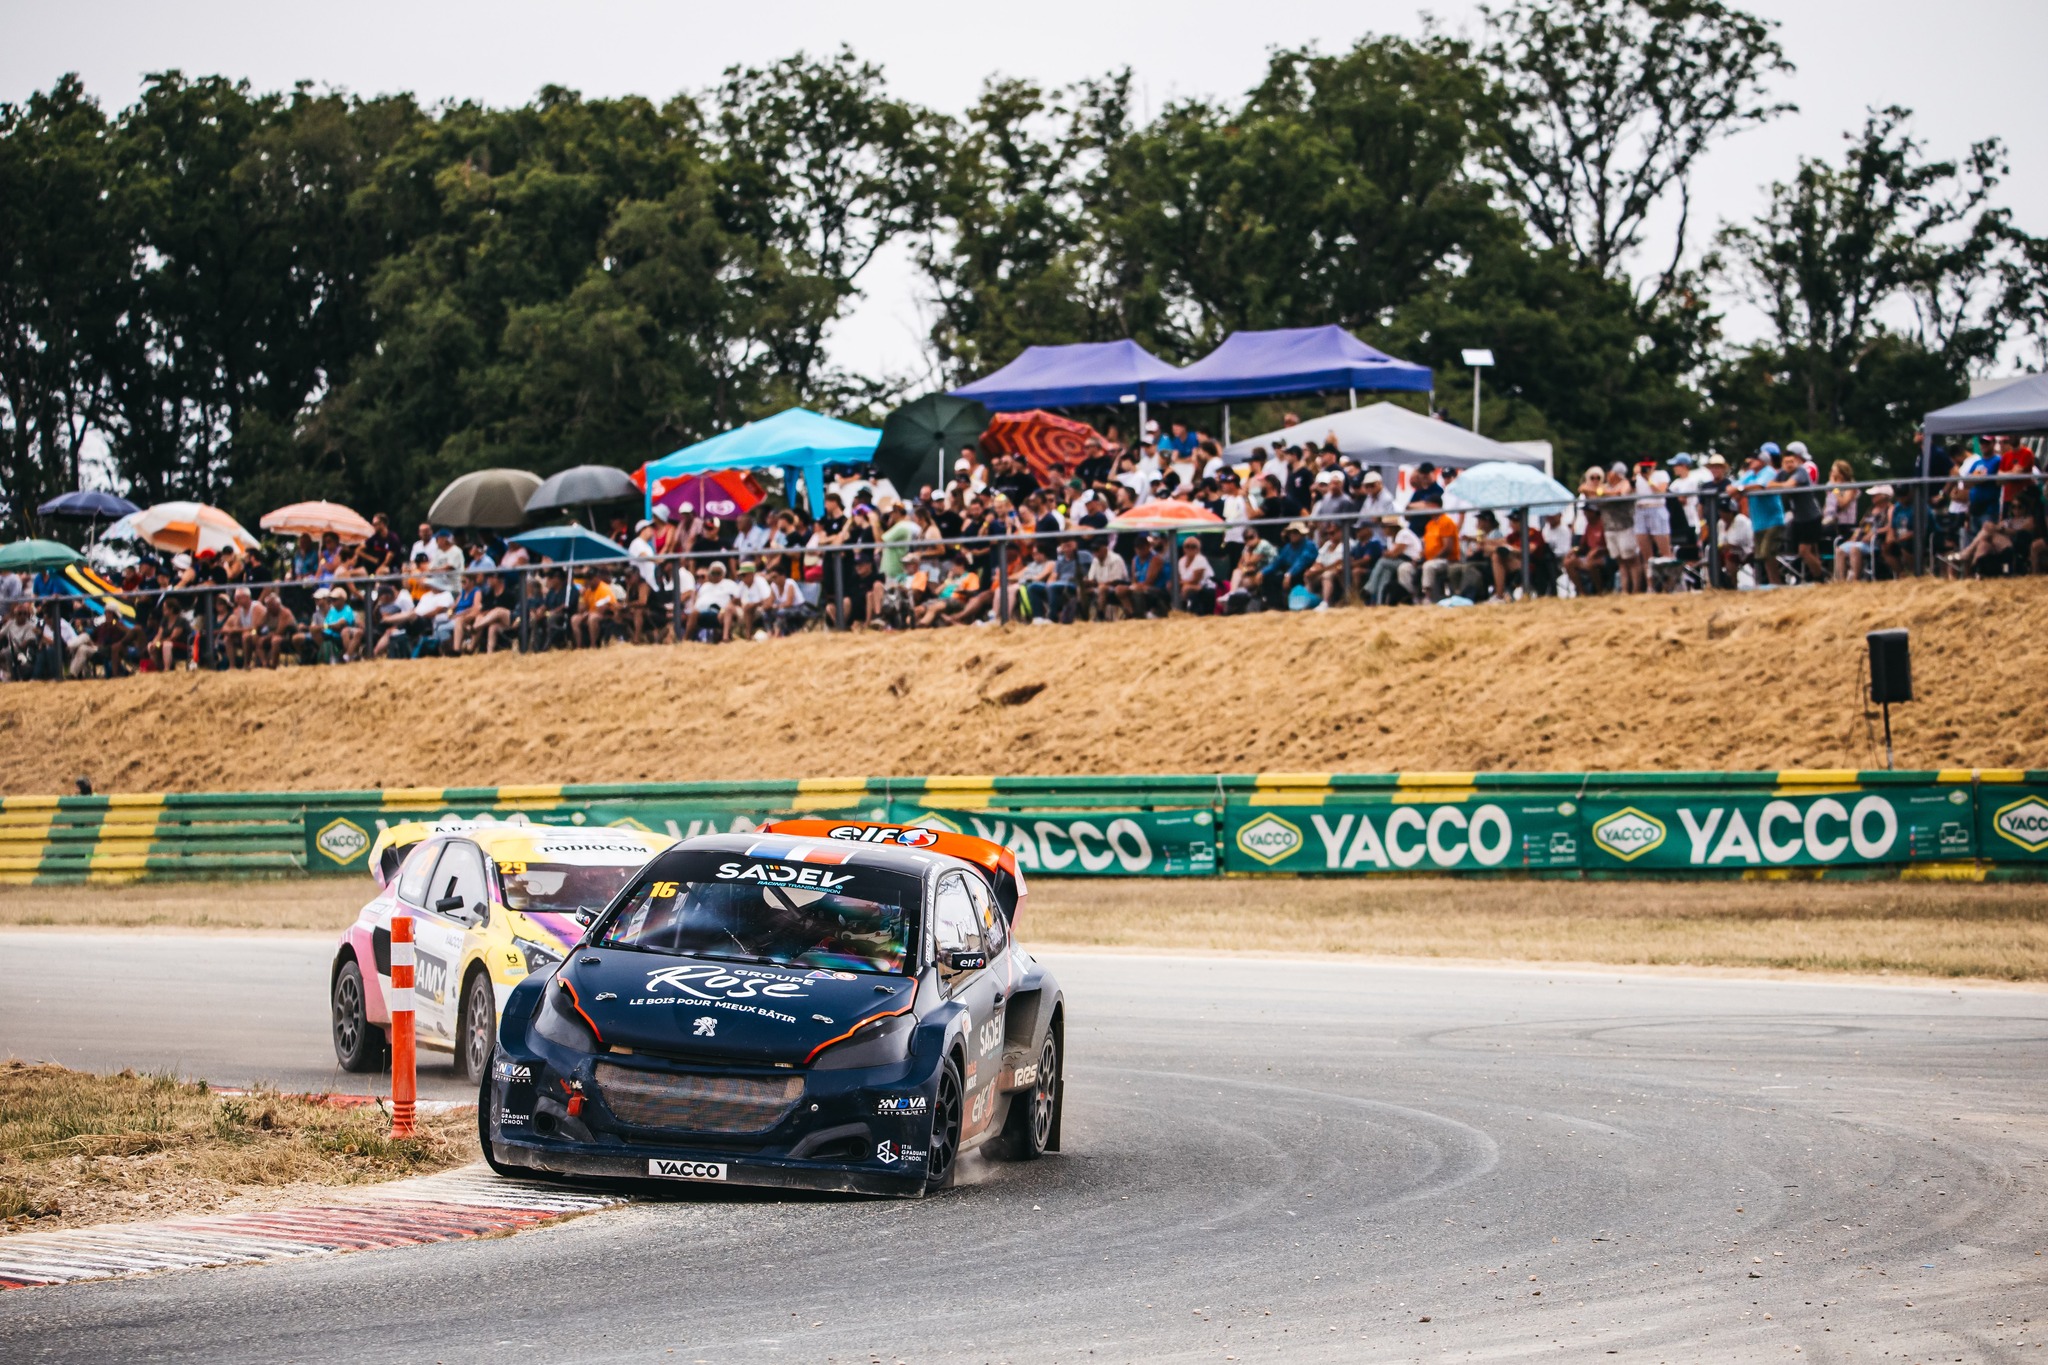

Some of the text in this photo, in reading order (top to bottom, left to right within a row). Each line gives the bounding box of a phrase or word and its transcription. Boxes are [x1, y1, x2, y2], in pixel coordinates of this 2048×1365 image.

[1676, 795, 1898, 864] YACCO
[2007, 816, 2048, 831] YACC
[326, 833, 361, 848] YACCO
[829, 825, 900, 843] elf
[1249, 833, 1293, 846] YACCO
[1310, 804, 1513, 868] YACCO
[1604, 827, 1655, 843] YACCO
[543, 843, 648, 854] PODIOCOM
[969, 817, 1153, 871] YACCO
[498, 862, 527, 875] 29
[715, 862, 855, 888] SADEV
[649, 881, 680, 898] 16
[787, 882, 841, 895] TRANSMISSION
[960, 958, 976, 968] elf
[646, 965, 809, 1000] Rose
[734, 969, 816, 986] GROUPE
[629, 997, 796, 1024] LE BOIS POUR MIEUX BÂTIR
[1014, 1063, 1038, 1088] RRS
[656, 1160, 720, 1179] YACCO
